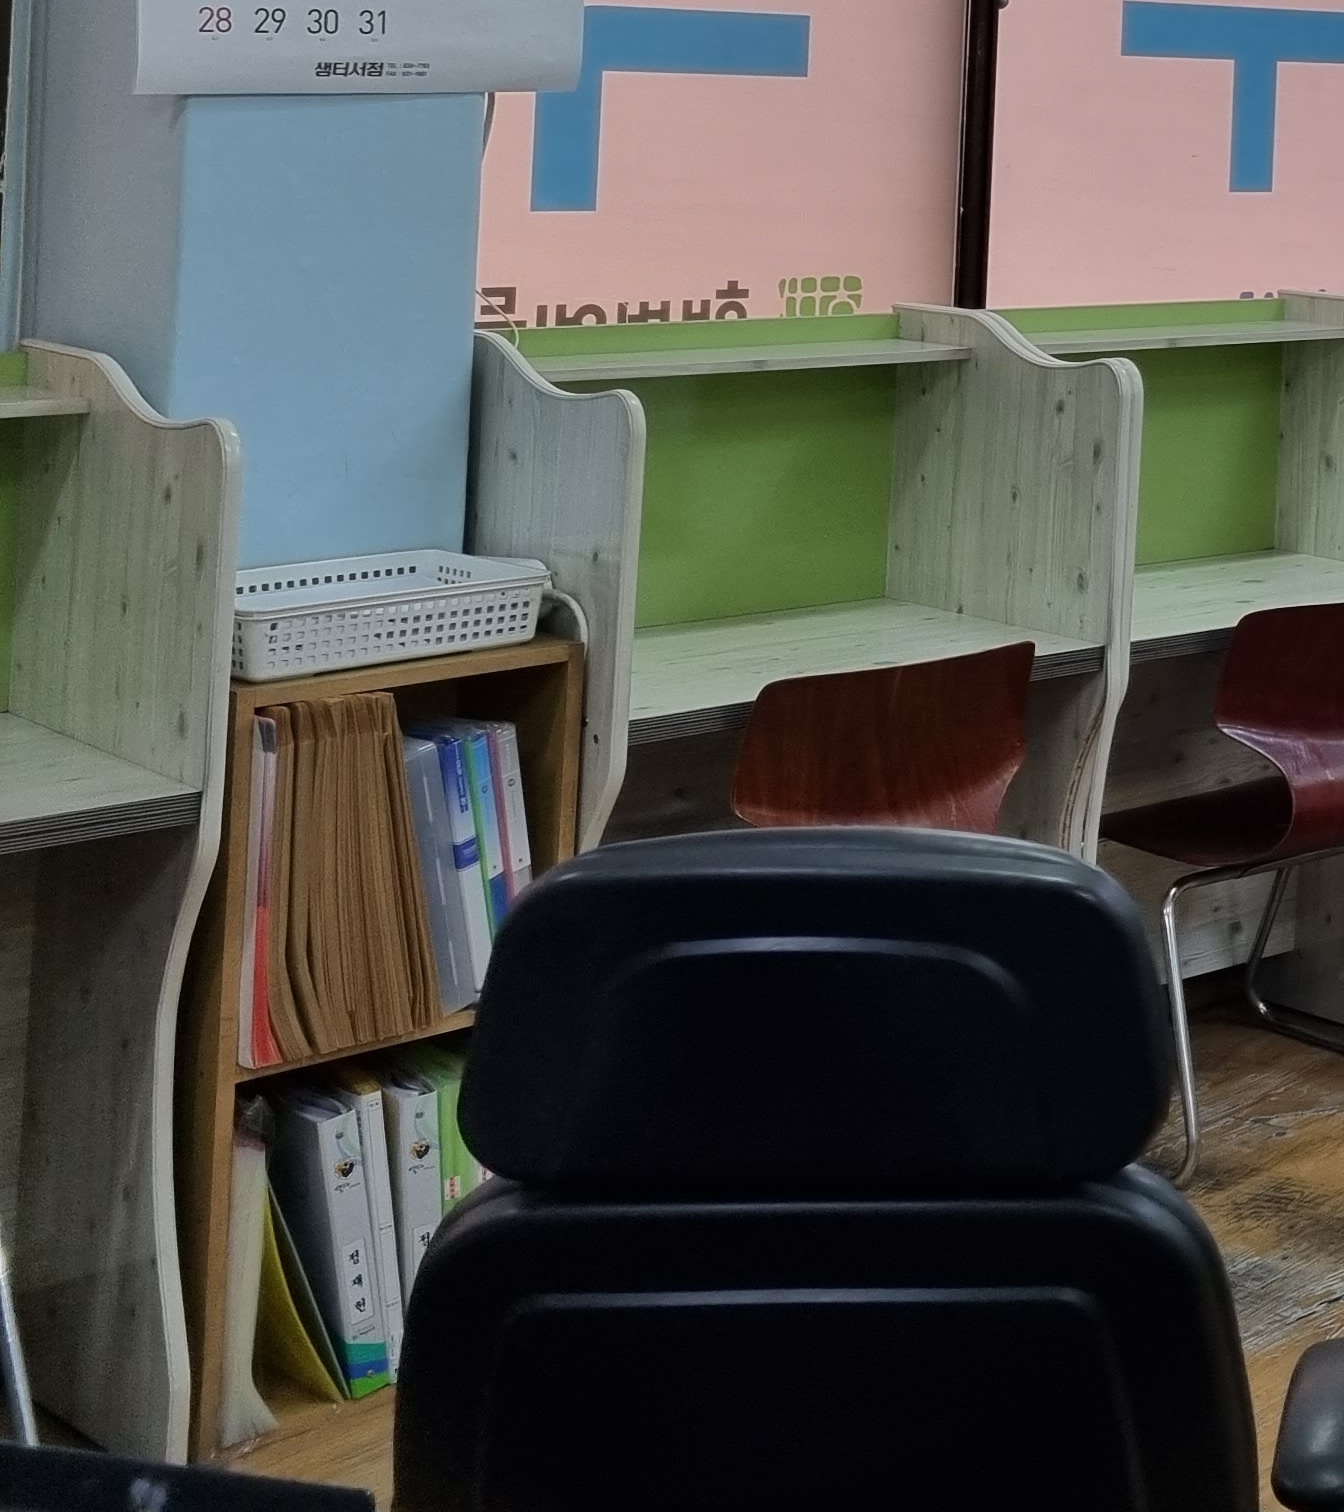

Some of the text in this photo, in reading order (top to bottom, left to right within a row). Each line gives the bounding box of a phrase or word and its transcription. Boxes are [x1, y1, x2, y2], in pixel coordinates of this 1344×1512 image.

[199, 7, 385, 34] 28 29 30 31
[315, 61, 385, 77] 샘터서점
